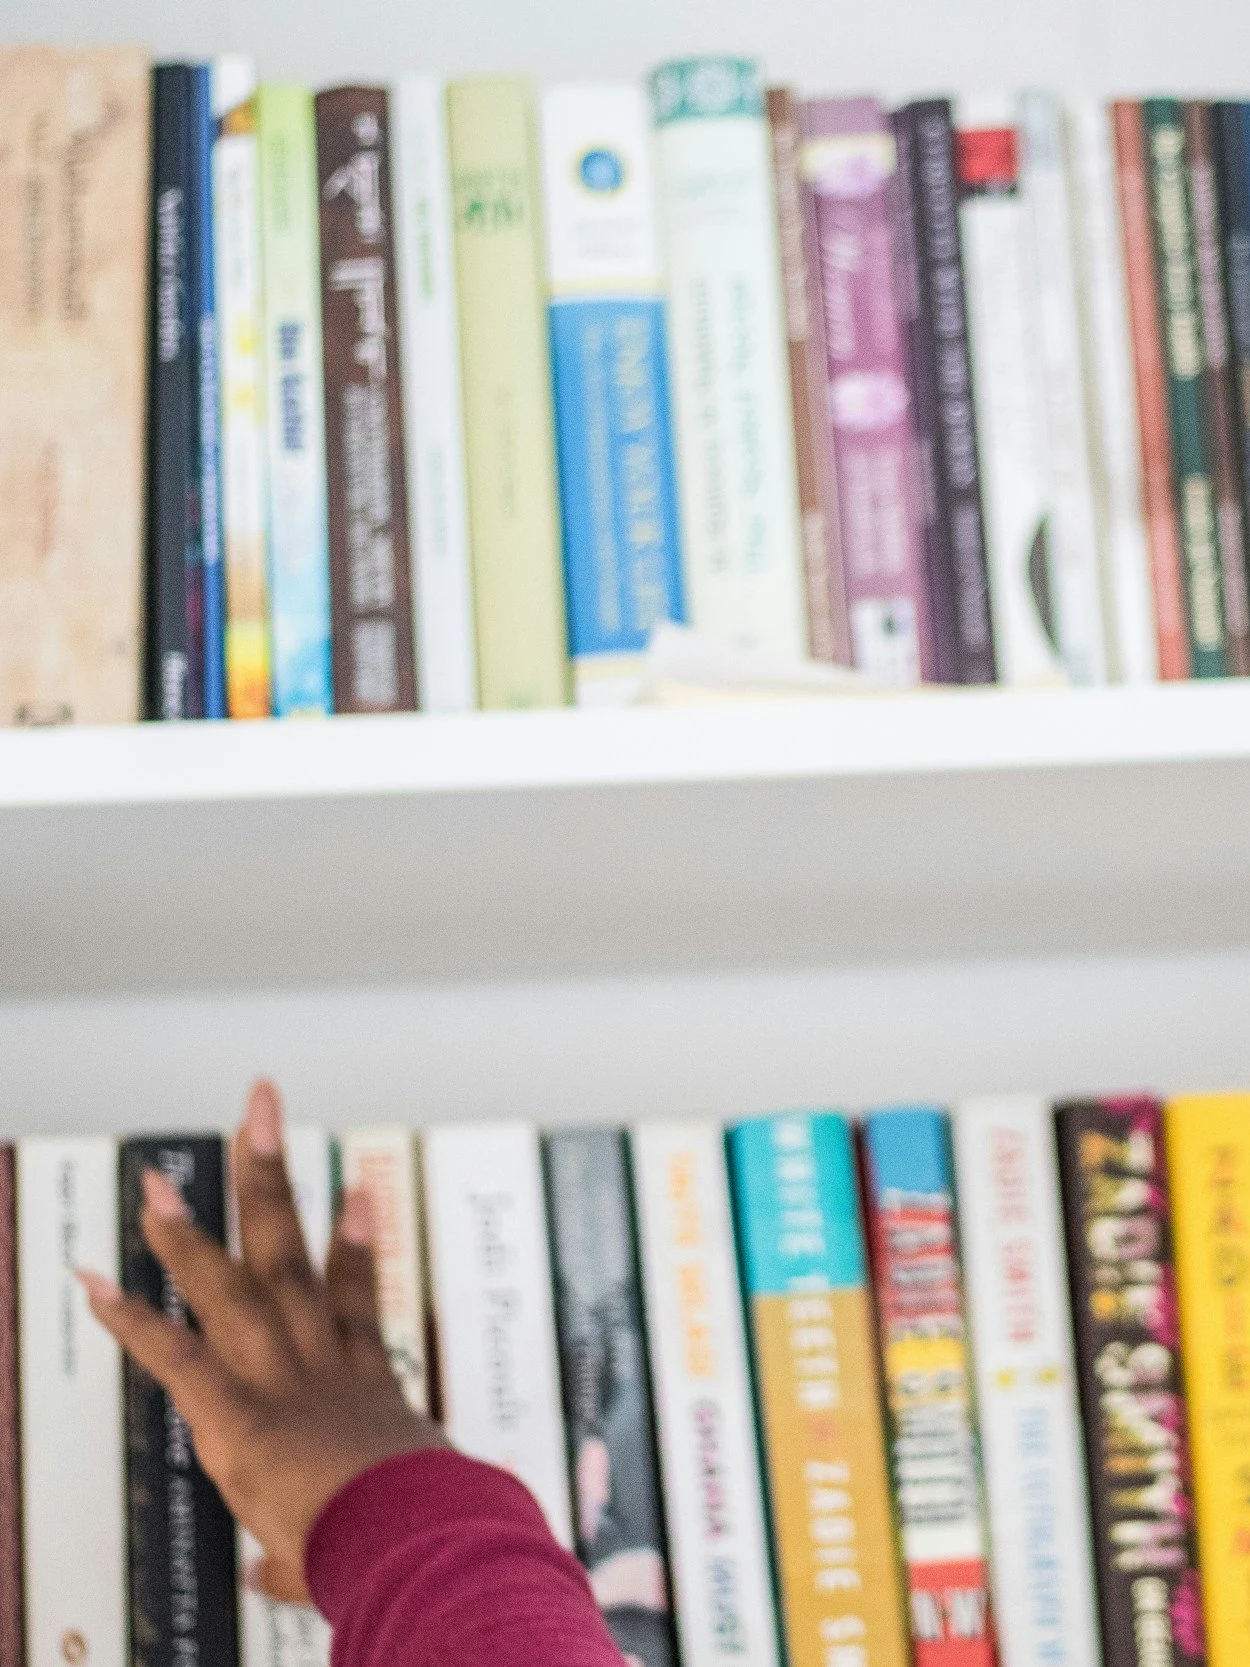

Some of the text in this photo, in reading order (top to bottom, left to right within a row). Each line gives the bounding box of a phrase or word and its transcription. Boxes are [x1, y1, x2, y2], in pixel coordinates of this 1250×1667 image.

[772, 1118, 840, 1410] WHITE TEETH
[1080, 1131, 1164, 1322] ZADIE
[805, 1461, 863, 1592] ZADIE
[1094, 1340, 1188, 1573] SMITH
